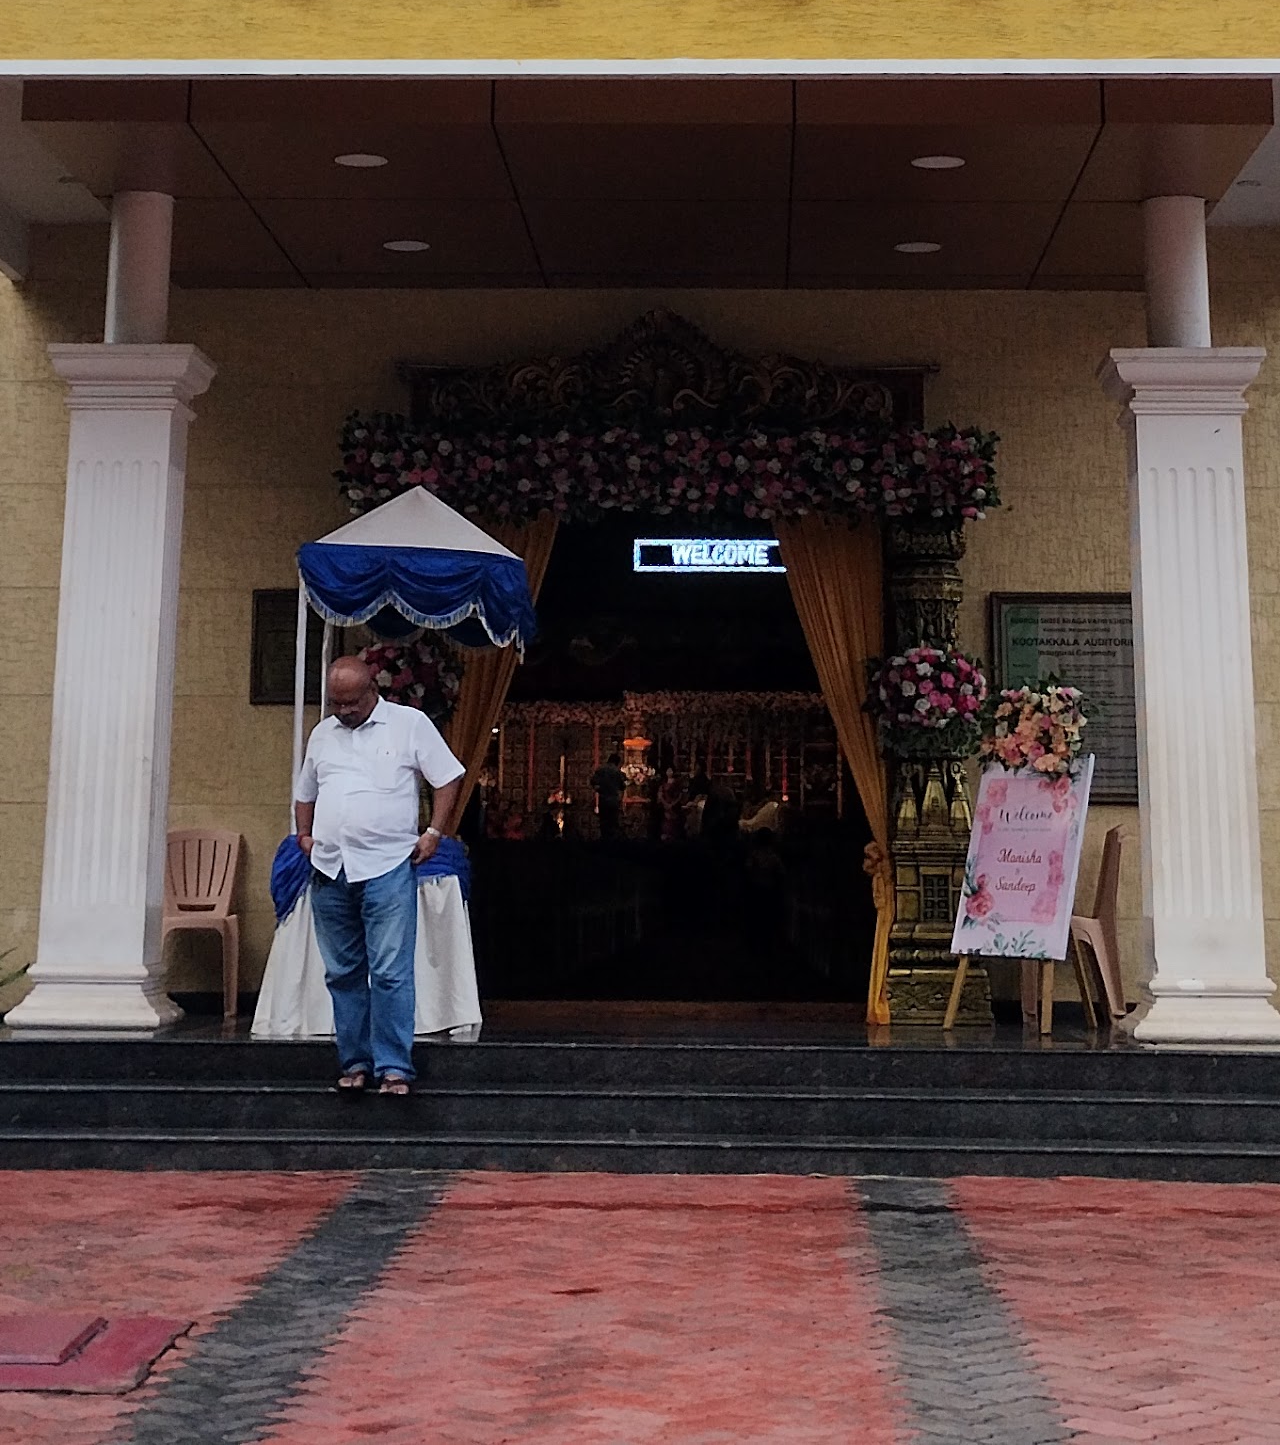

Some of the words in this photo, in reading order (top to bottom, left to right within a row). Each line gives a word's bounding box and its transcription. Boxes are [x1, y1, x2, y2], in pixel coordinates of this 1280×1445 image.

[671, 544, 770, 565] WELCOME
[1012, 638, 1080, 646] KOOTAKKALA
[999, 804, 1053, 824] Welcome
[996, 847, 1042, 864] Manisha
[995, 875, 1036, 896] Sandeep
